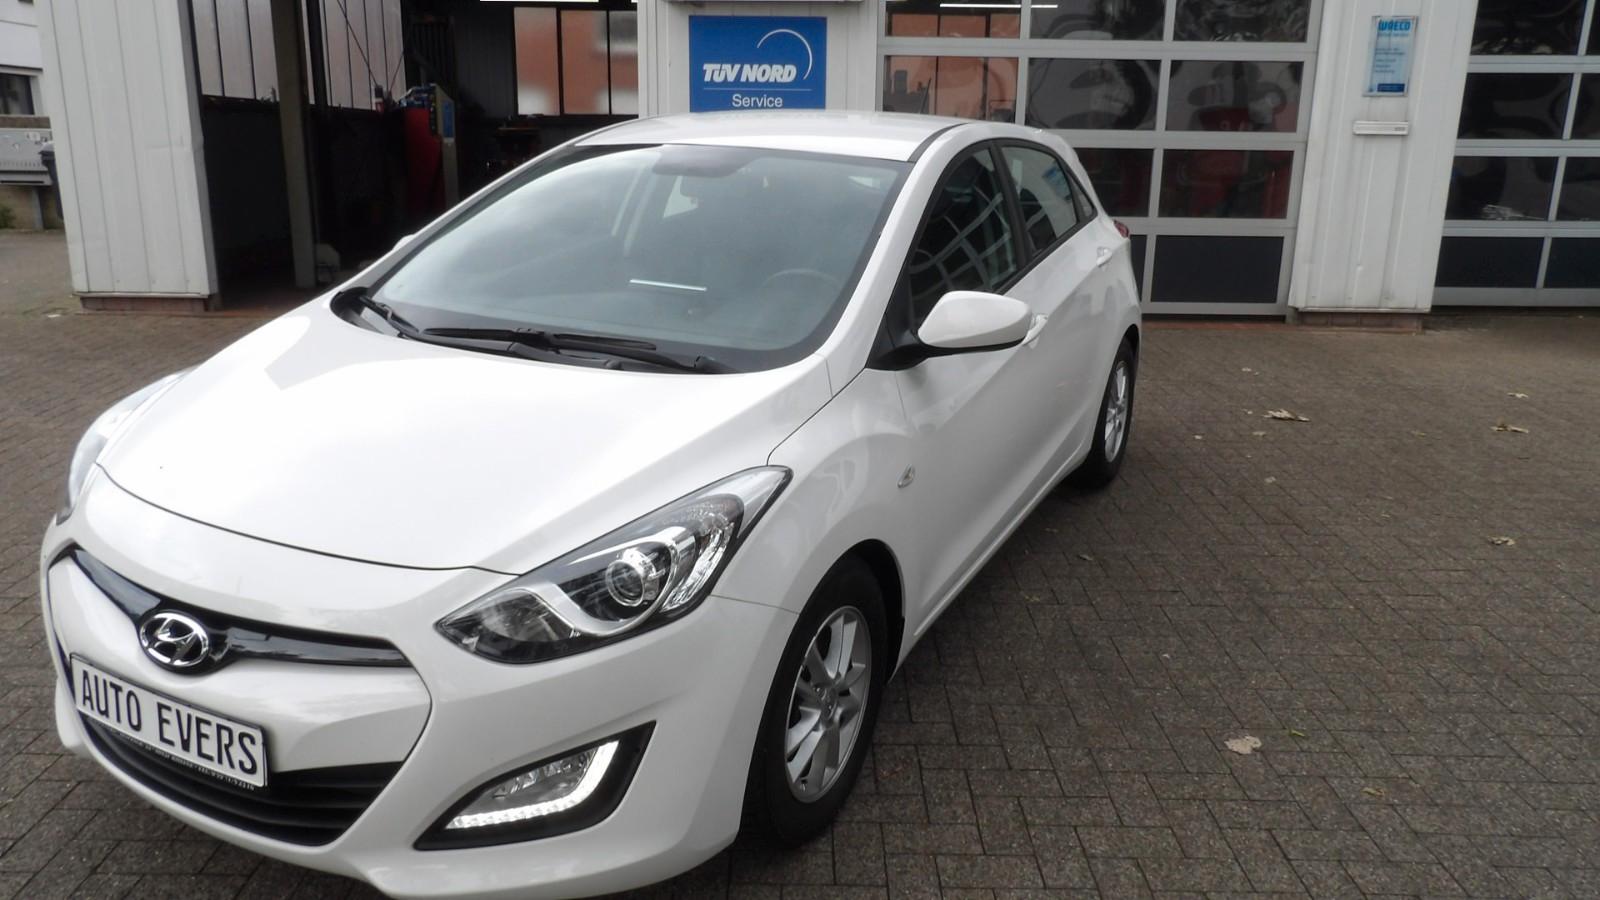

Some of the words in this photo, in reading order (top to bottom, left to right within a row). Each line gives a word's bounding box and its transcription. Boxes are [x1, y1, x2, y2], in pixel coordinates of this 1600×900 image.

[702, 63, 741, 83] TÜV
[739, 64, 797, 83] NORD
[731, 93, 783, 108] Service
[82, 669, 142, 732] AUTO
[156, 701, 258, 775] EVERS
